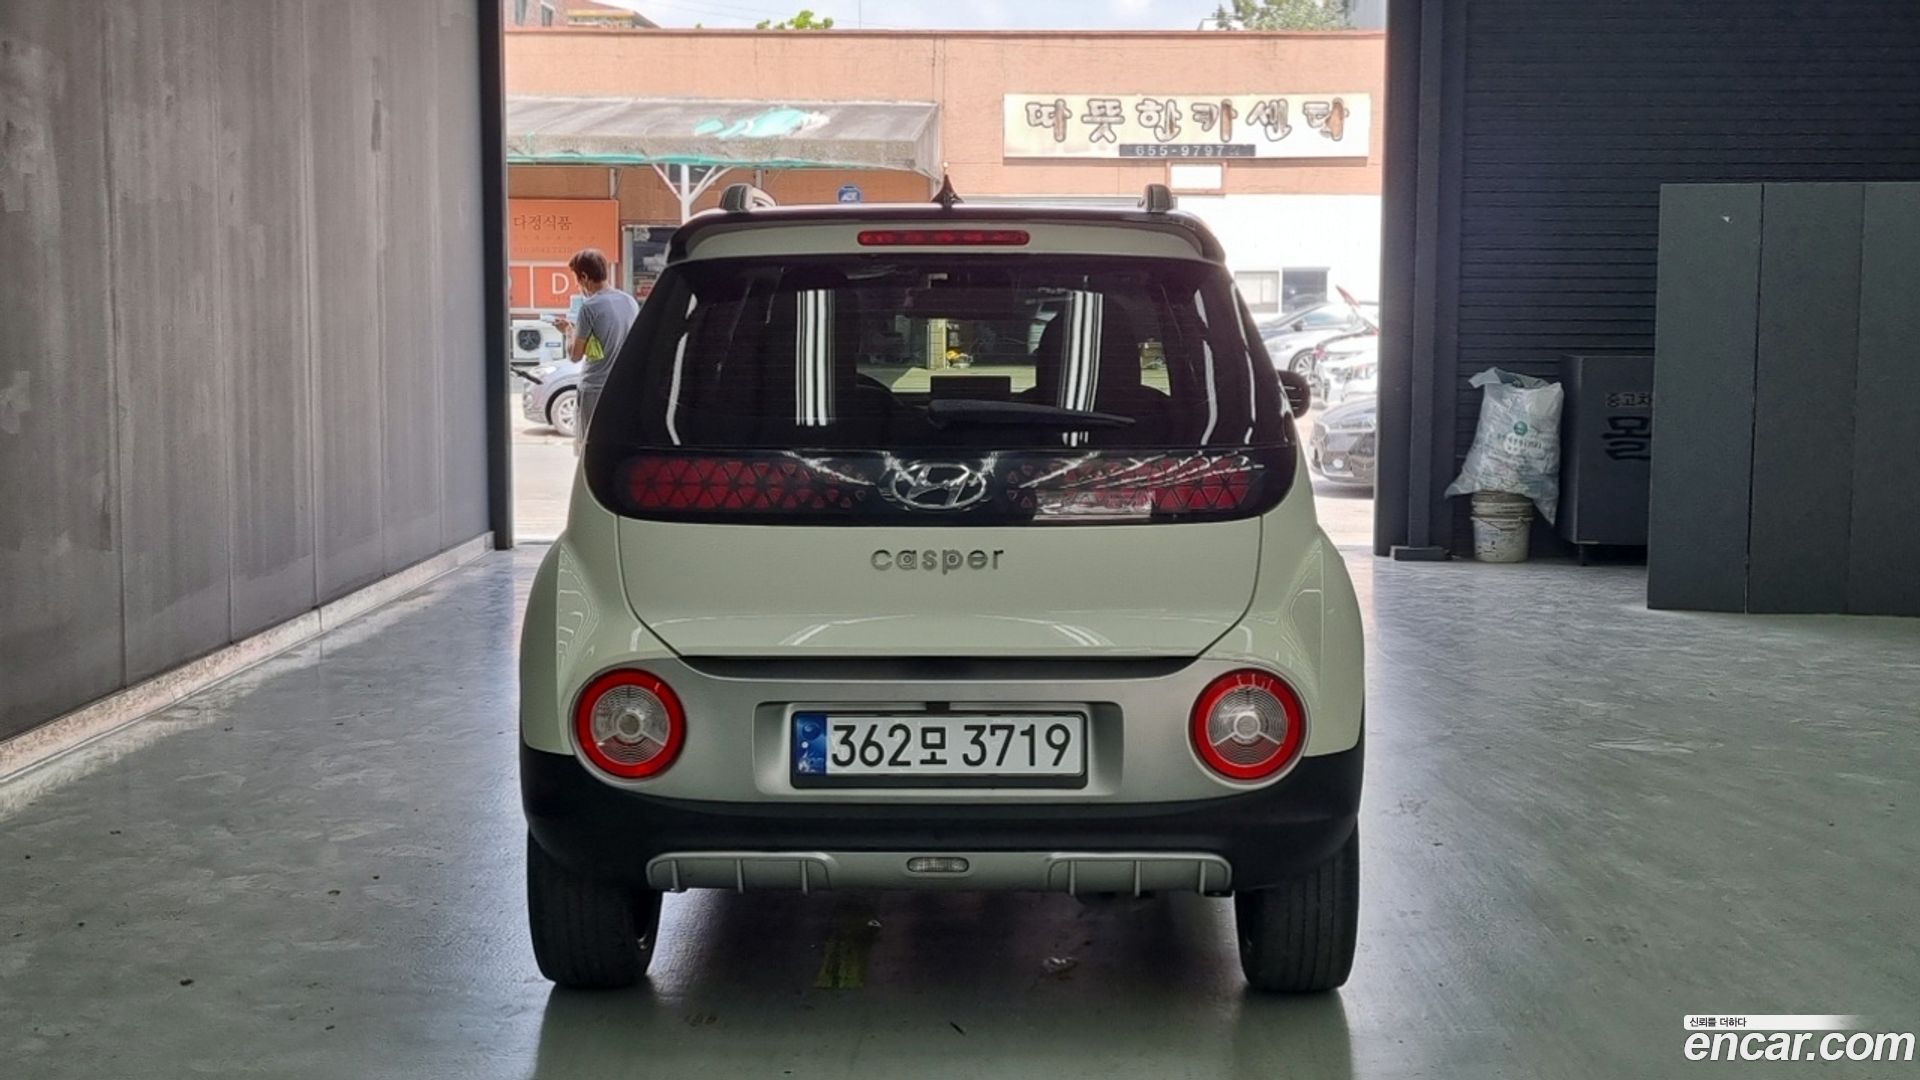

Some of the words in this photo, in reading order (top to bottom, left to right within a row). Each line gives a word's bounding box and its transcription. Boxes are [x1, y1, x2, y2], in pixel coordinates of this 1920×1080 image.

[1135, 145, 1225, 156] 655-9797
[513, 215, 573, 231] 다정식품
[870, 549, 1004, 575] casper
[831, 723, 947, 767] 362모
[962, 723, 1071, 767] 3719
